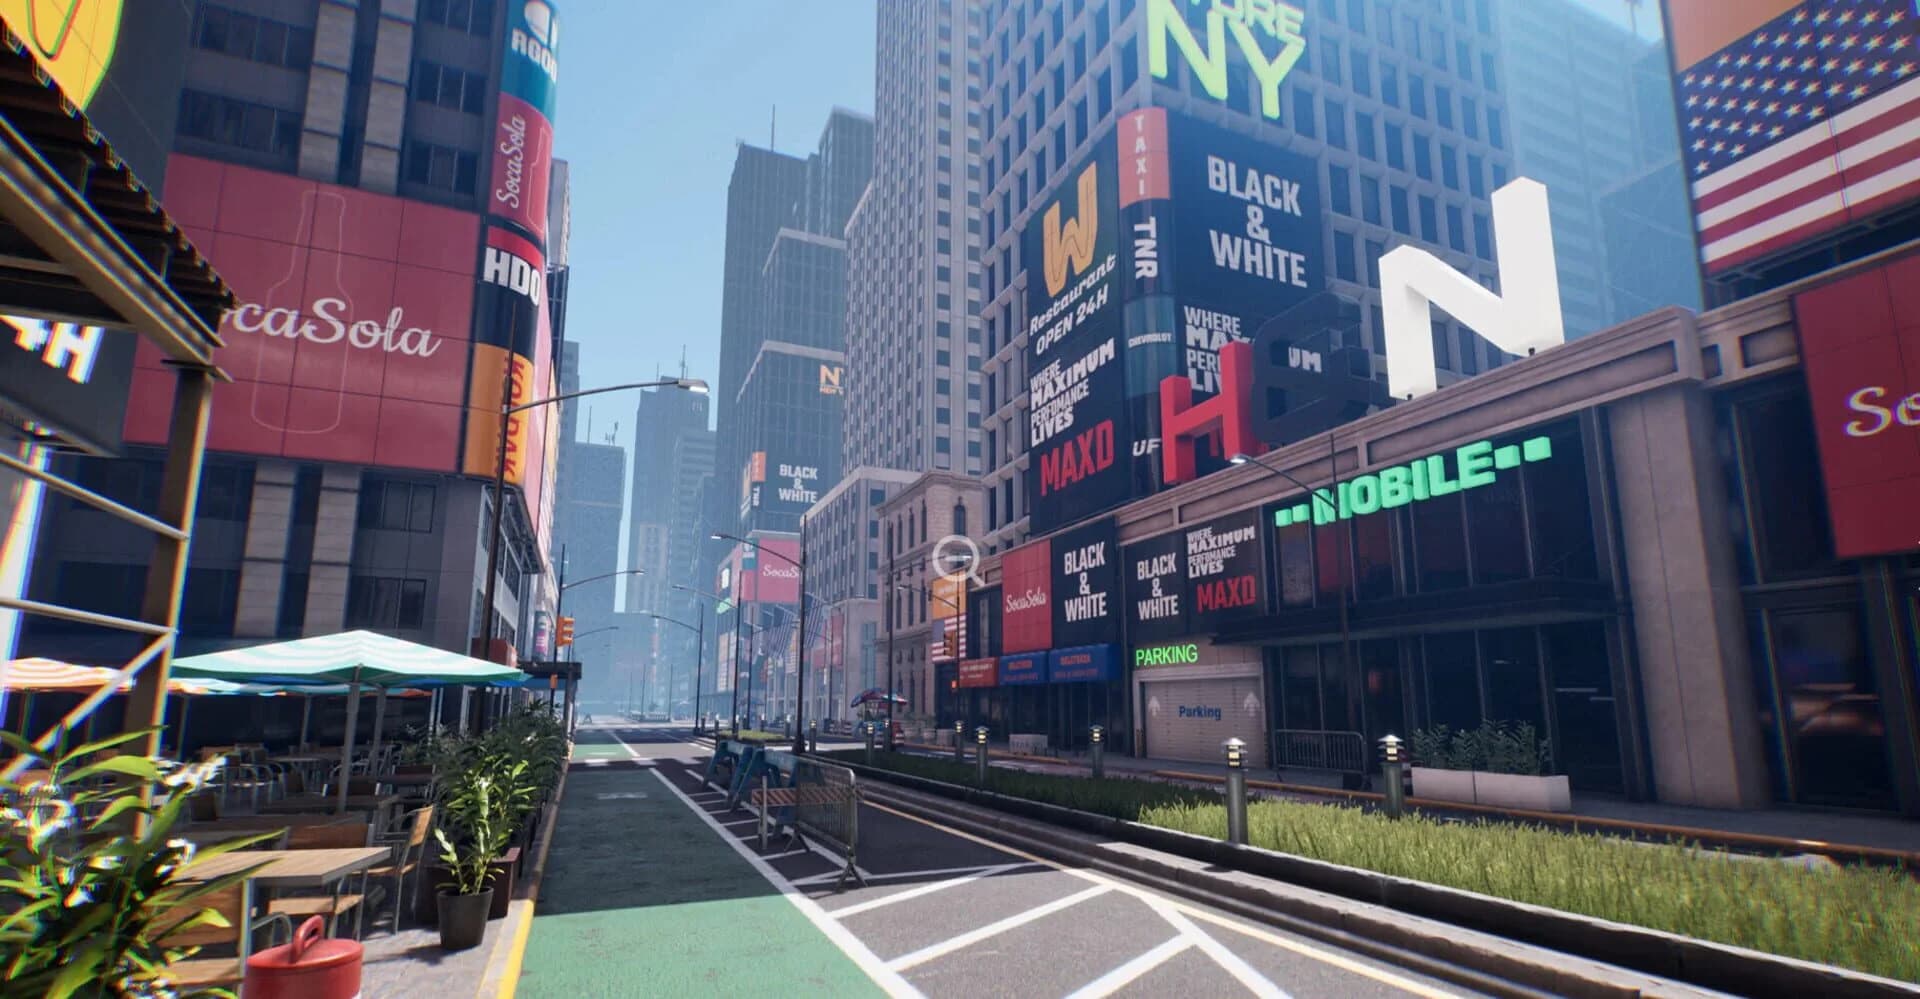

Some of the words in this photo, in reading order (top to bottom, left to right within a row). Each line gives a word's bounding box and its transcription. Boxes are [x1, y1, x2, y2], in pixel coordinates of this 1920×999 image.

[1147, 0, 1306, 119] NY
[495, 114, 526, 209] SocaSola
[1134, 115, 1147, 196] TAXI
[1207, 154, 1302, 217] BLACK
[1043, 160, 1098, 298] W
[1246, 204, 1272, 245] &
[1134, 216, 1158, 279] TNR
[1209, 229, 1308, 288] WHITE
[1029, 254, 1116, 336] Restaurant
[222, 298, 442, 357] caSola
[1036, 313, 1073, 356] OPEN
[1076, 283, 1108, 325] 24H
[1184, 305, 1242, 335] WHERE
[1030, 359, 1062, 393] WHERE
[1031, 338, 1116, 412] MAXIMUM
[1032, 407, 1074, 448] LIVES
[779, 464, 818, 480] BLACK
[1040, 419, 1115, 497] MAXD
[778, 487, 818, 503] WHITE
[1064, 541, 1105, 575] BLACK
[1188, 526, 1255, 555] MAXIMUM
[1080, 572, 1091, 595] &
[1137, 553, 1176, 580] BLACK
[1189, 560, 1224, 579] LIVES
[1005, 587, 1047, 613] SocaSola
[1152, 578, 1162, 598] &
[1197, 575, 1256, 614] MAXD
[1065, 592, 1107, 622] WHITE
[1138, 595, 1179, 621] WHITE
[1135, 643, 1198, 667] PARKING
[1178, 705, 1222, 721] Parking
